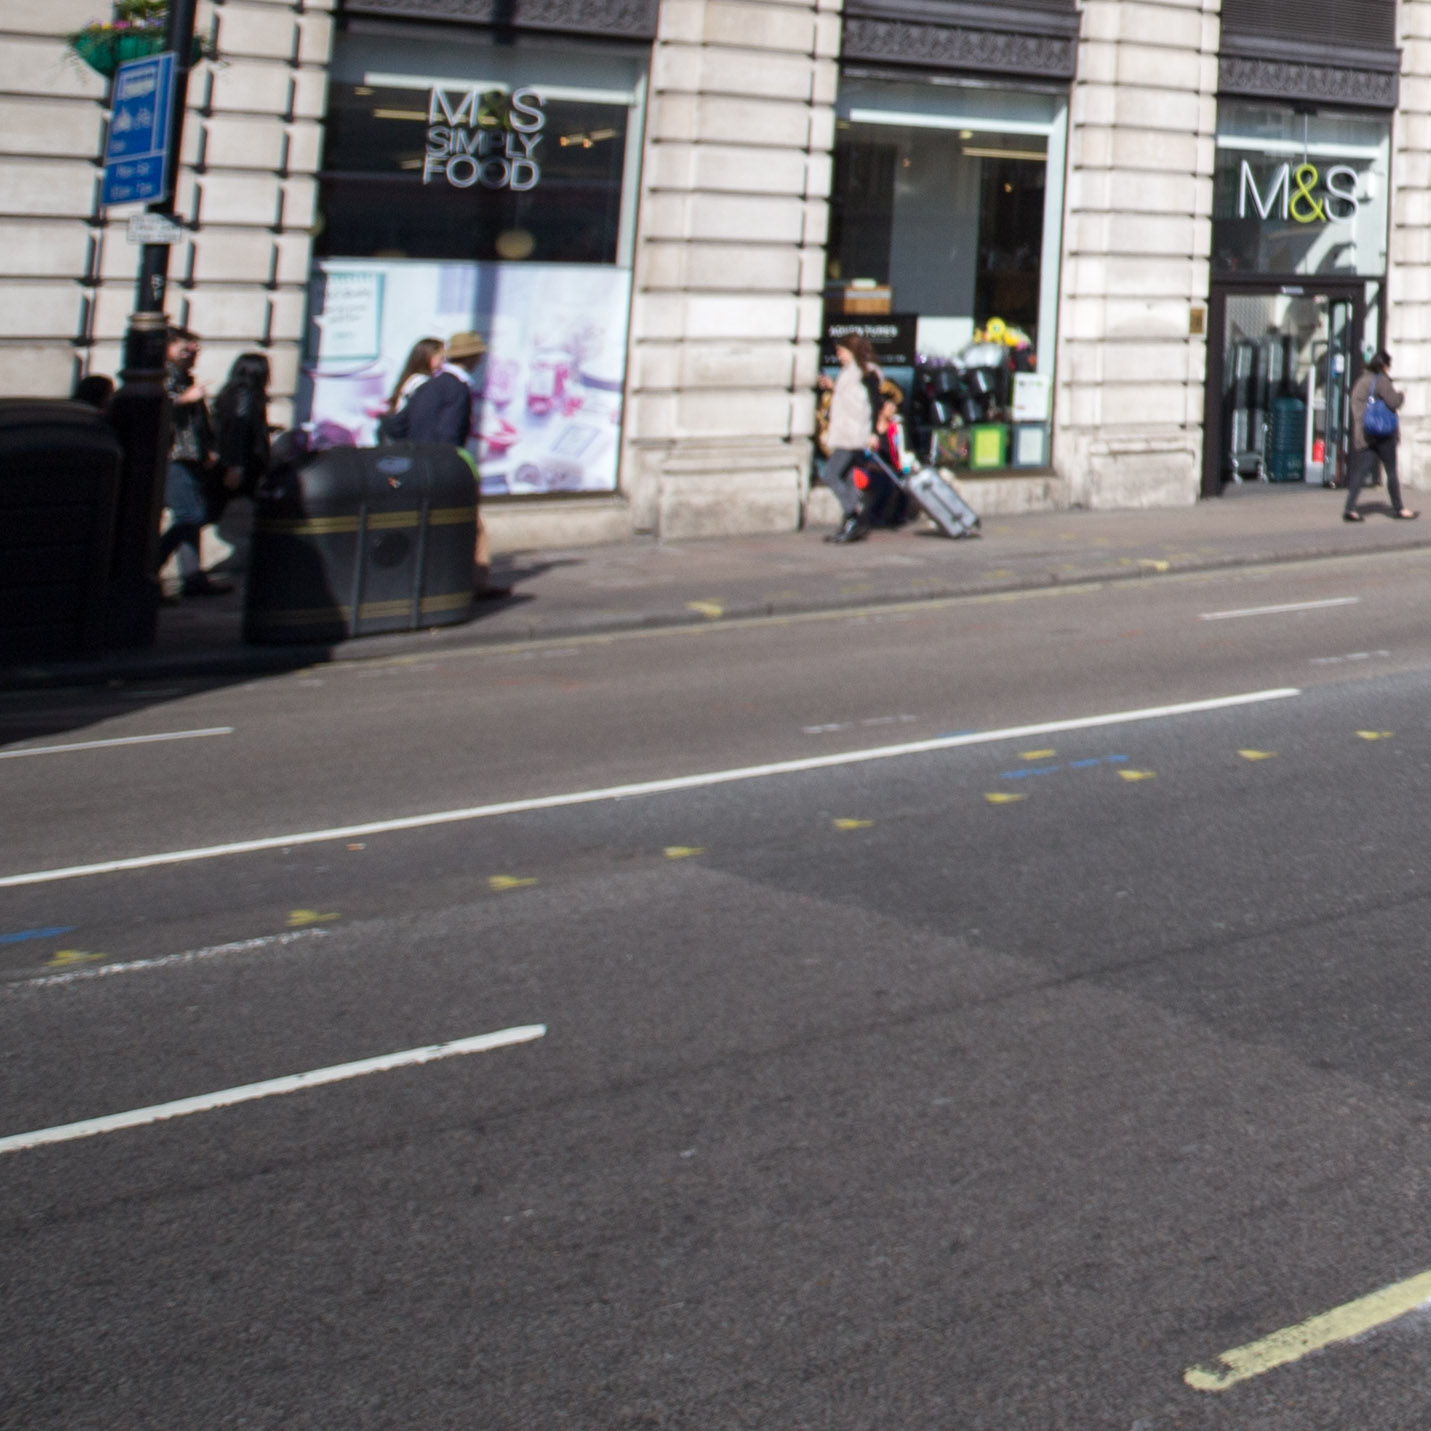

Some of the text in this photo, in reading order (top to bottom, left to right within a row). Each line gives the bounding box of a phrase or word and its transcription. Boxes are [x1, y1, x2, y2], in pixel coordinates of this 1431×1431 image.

[425, 125, 544, 160] SIMPLY
[422, 153, 540, 192] FOOD
[1239, 159, 1360, 224] M&S
